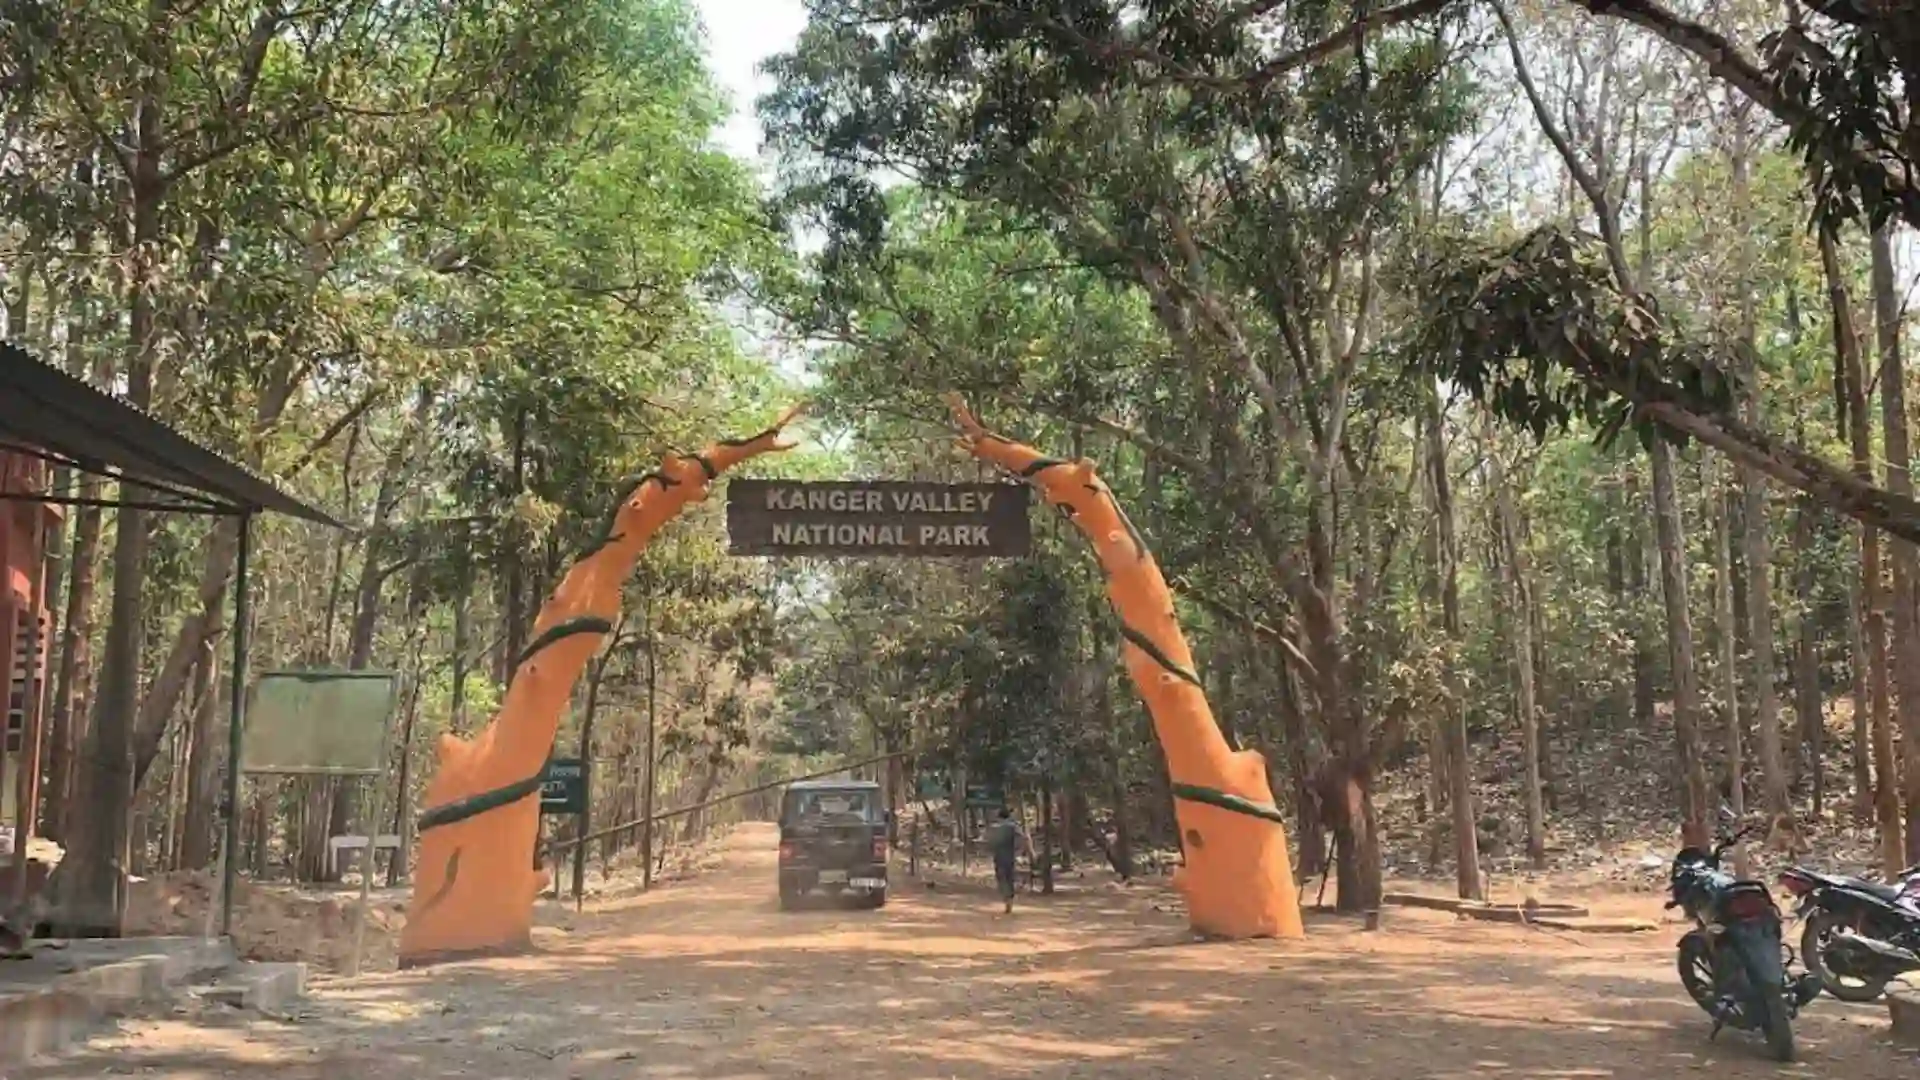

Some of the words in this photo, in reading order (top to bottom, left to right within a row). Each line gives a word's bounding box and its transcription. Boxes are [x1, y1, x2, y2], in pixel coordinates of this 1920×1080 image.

[765, 489, 883, 512] KANGER
[892, 490, 994, 513] VALLEY
[772, 523, 911, 546] NATIONAL
[919, 525, 990, 547] PARK
